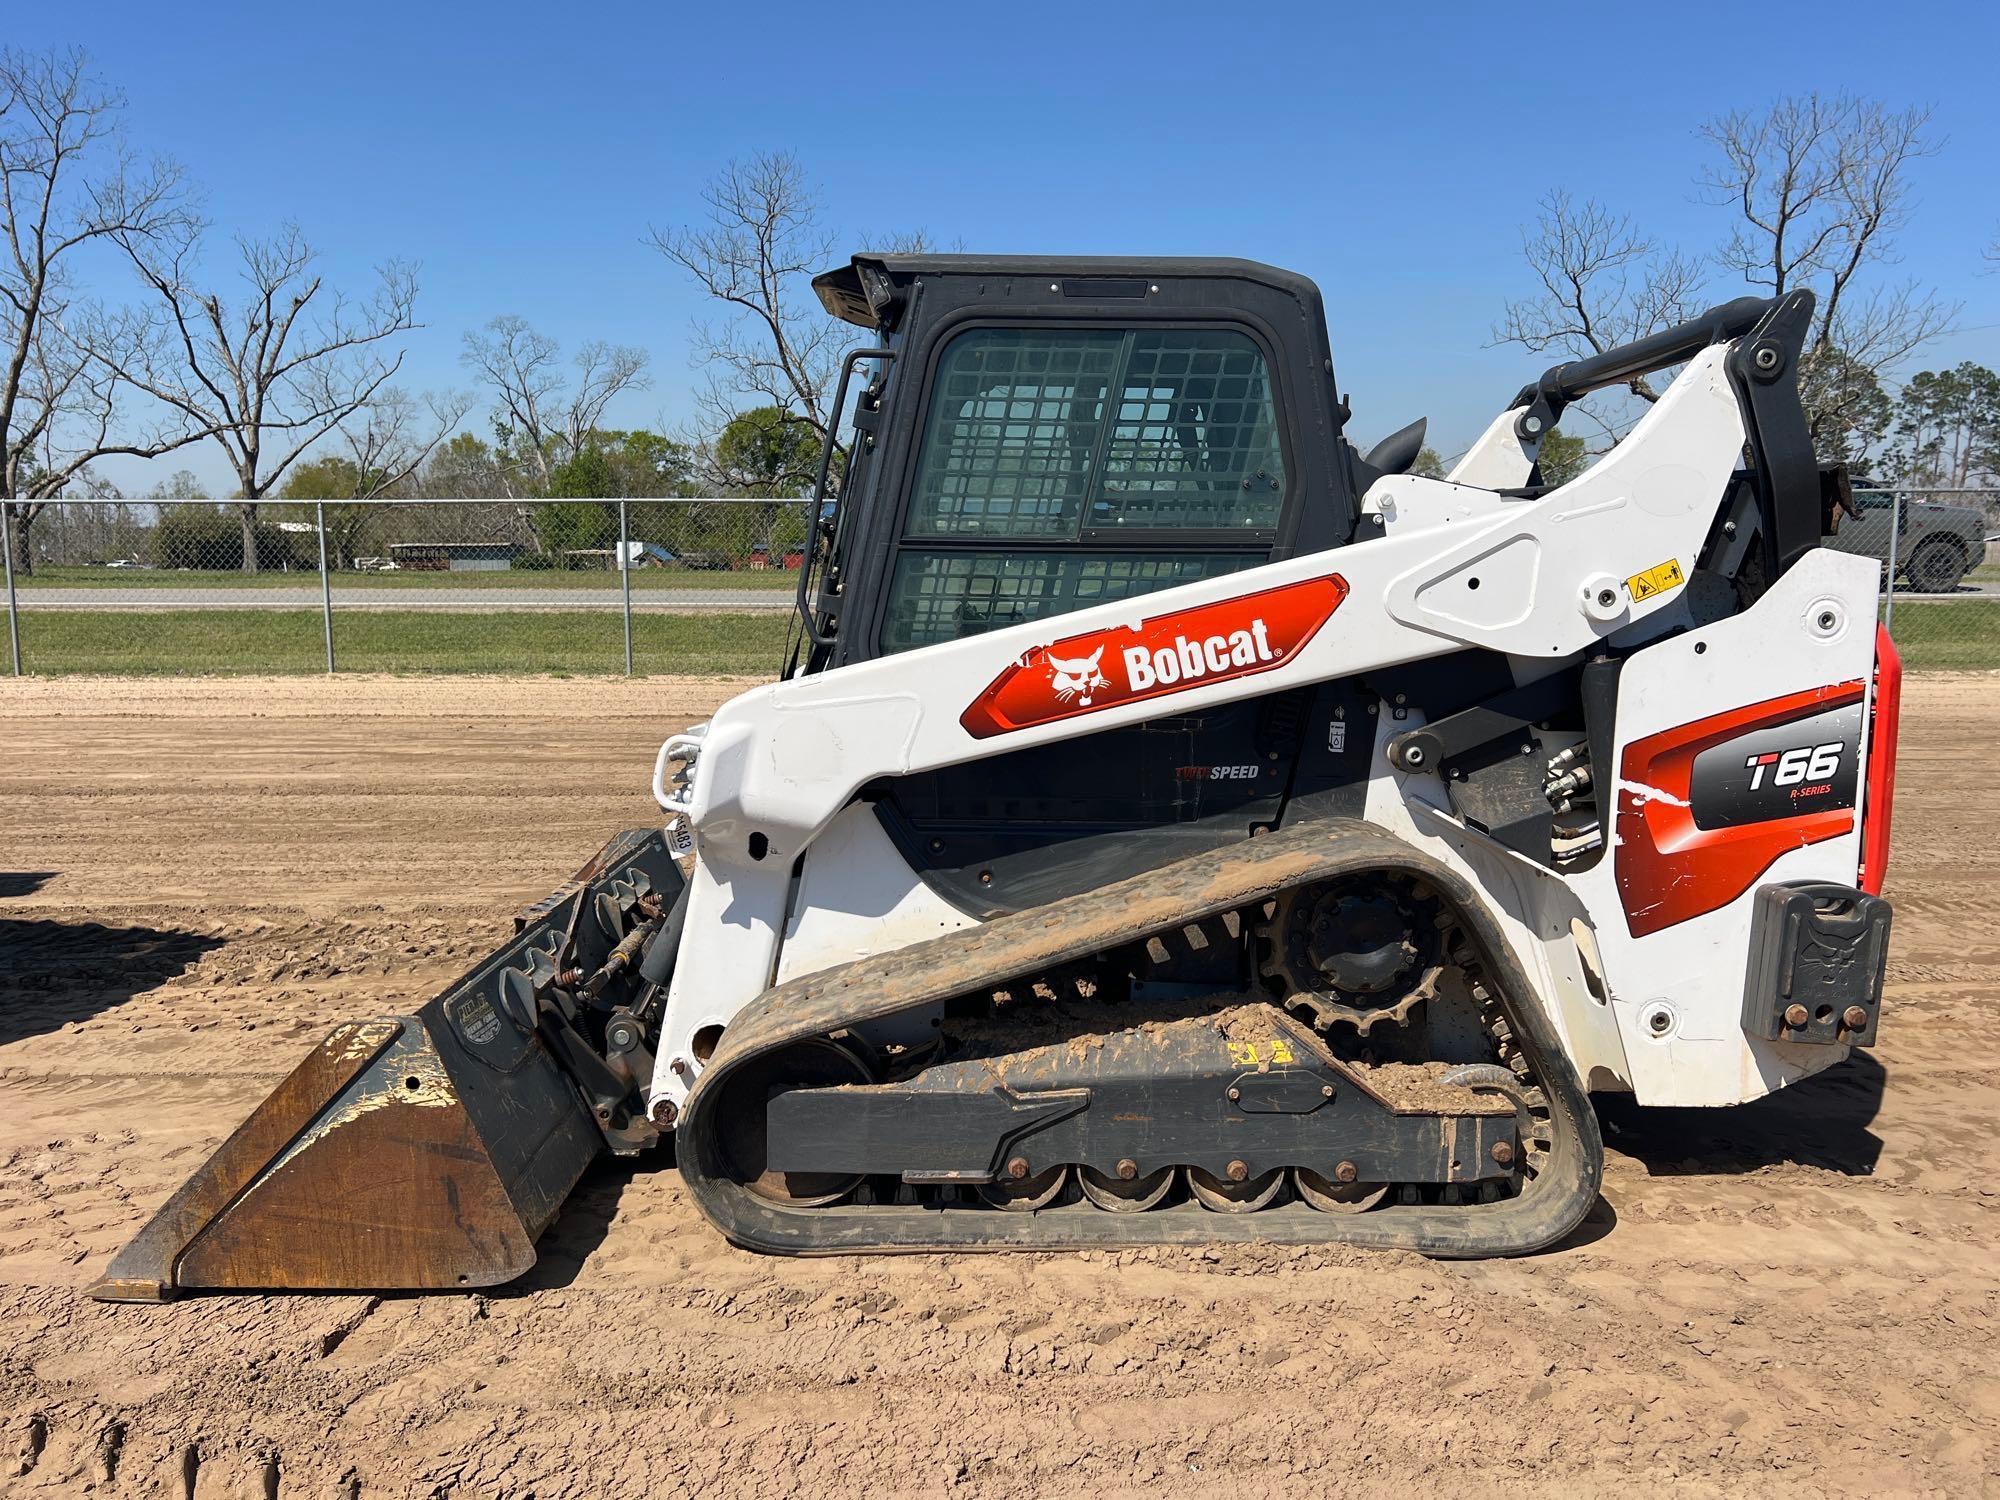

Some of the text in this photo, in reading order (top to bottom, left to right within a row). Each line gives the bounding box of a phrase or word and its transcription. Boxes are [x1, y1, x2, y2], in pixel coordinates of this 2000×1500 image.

[1122, 618, 1273, 692] Bobcat
[1210, 765, 1259, 780] SPEED
[1745, 742, 1844, 791] T66
[1790, 784, 1832, 799] R-SERIES
